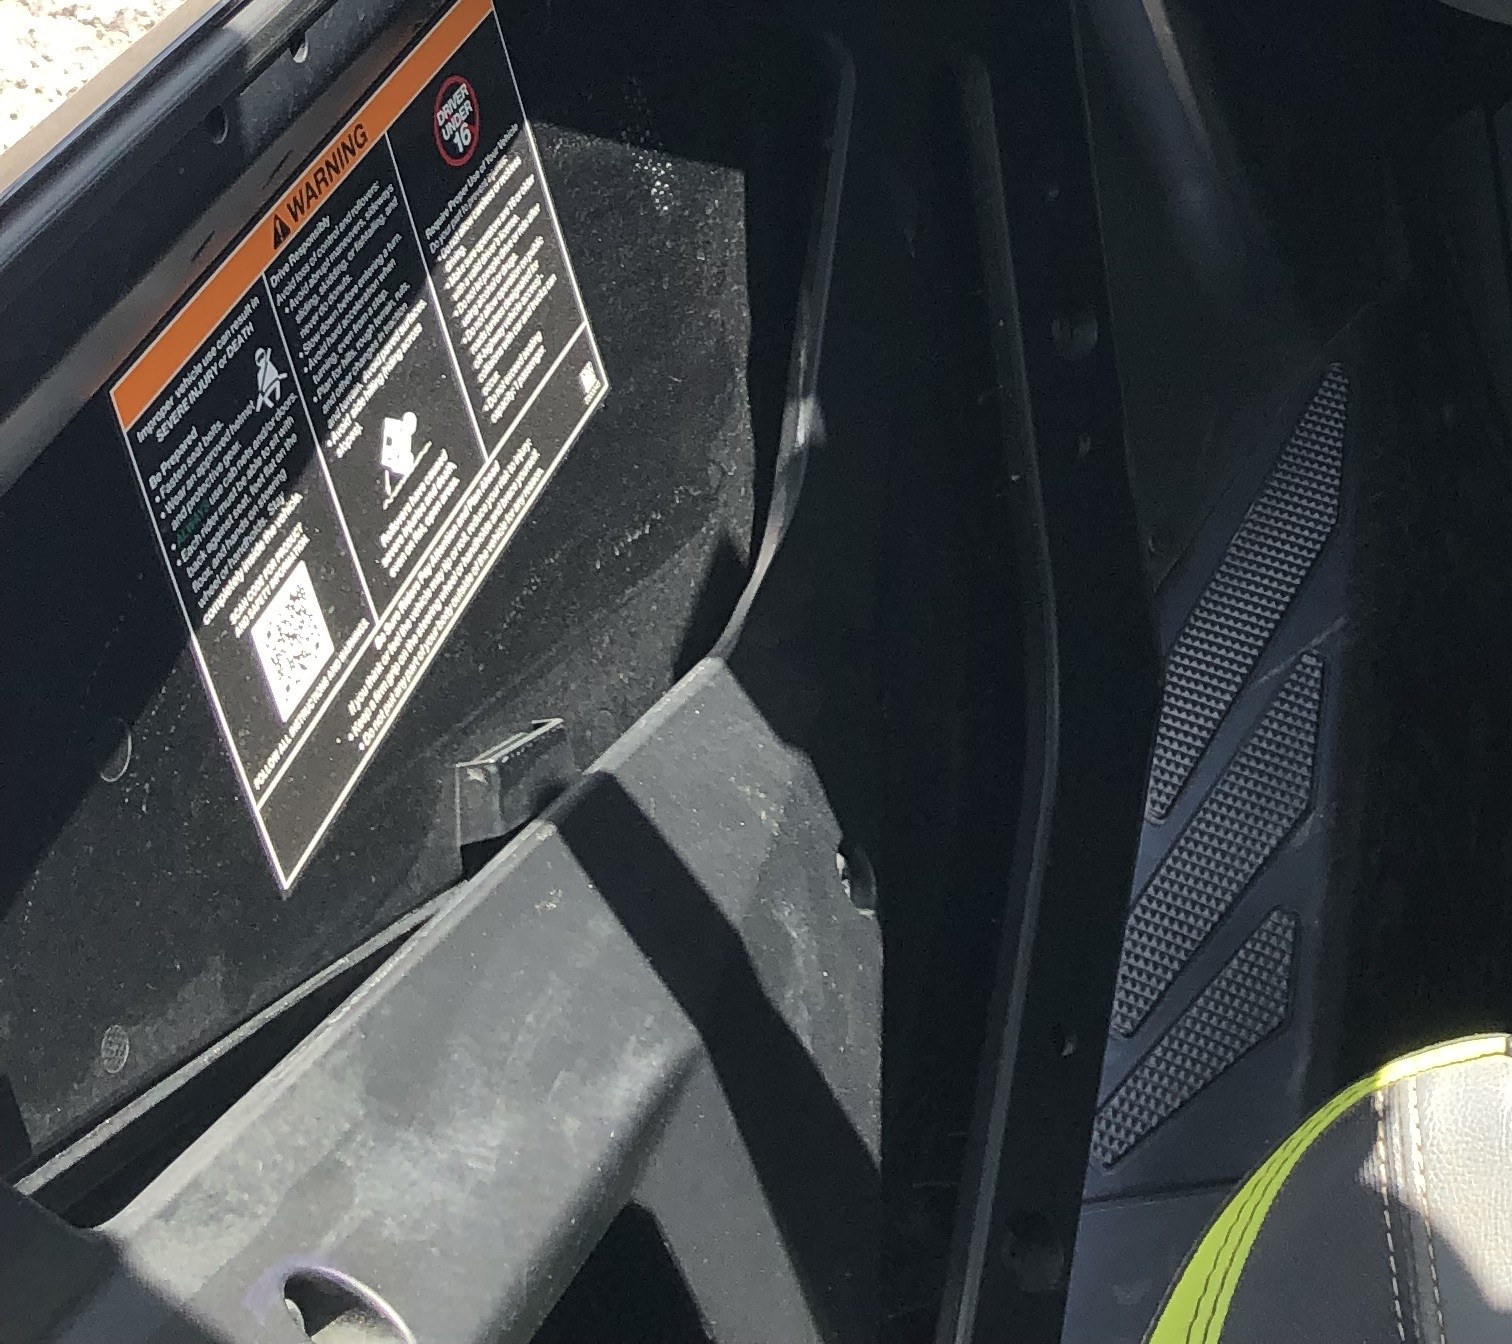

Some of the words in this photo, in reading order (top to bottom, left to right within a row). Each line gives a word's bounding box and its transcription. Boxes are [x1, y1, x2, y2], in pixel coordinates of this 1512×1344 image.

[435, 80, 468, 128] DRIVER
[441, 96, 473, 143] UNDER
[451, 118, 473, 157] 16
[286, 118, 368, 228] WARNING
[269, 259, 290, 290] Drive
[288, 211, 331, 270] Responsibly
[154, 395, 190, 444] SEVERE
[187, 361, 219, 406] INJURY
[225, 319, 254, 361] DEATH
[159, 423, 199, 479] Prepared
